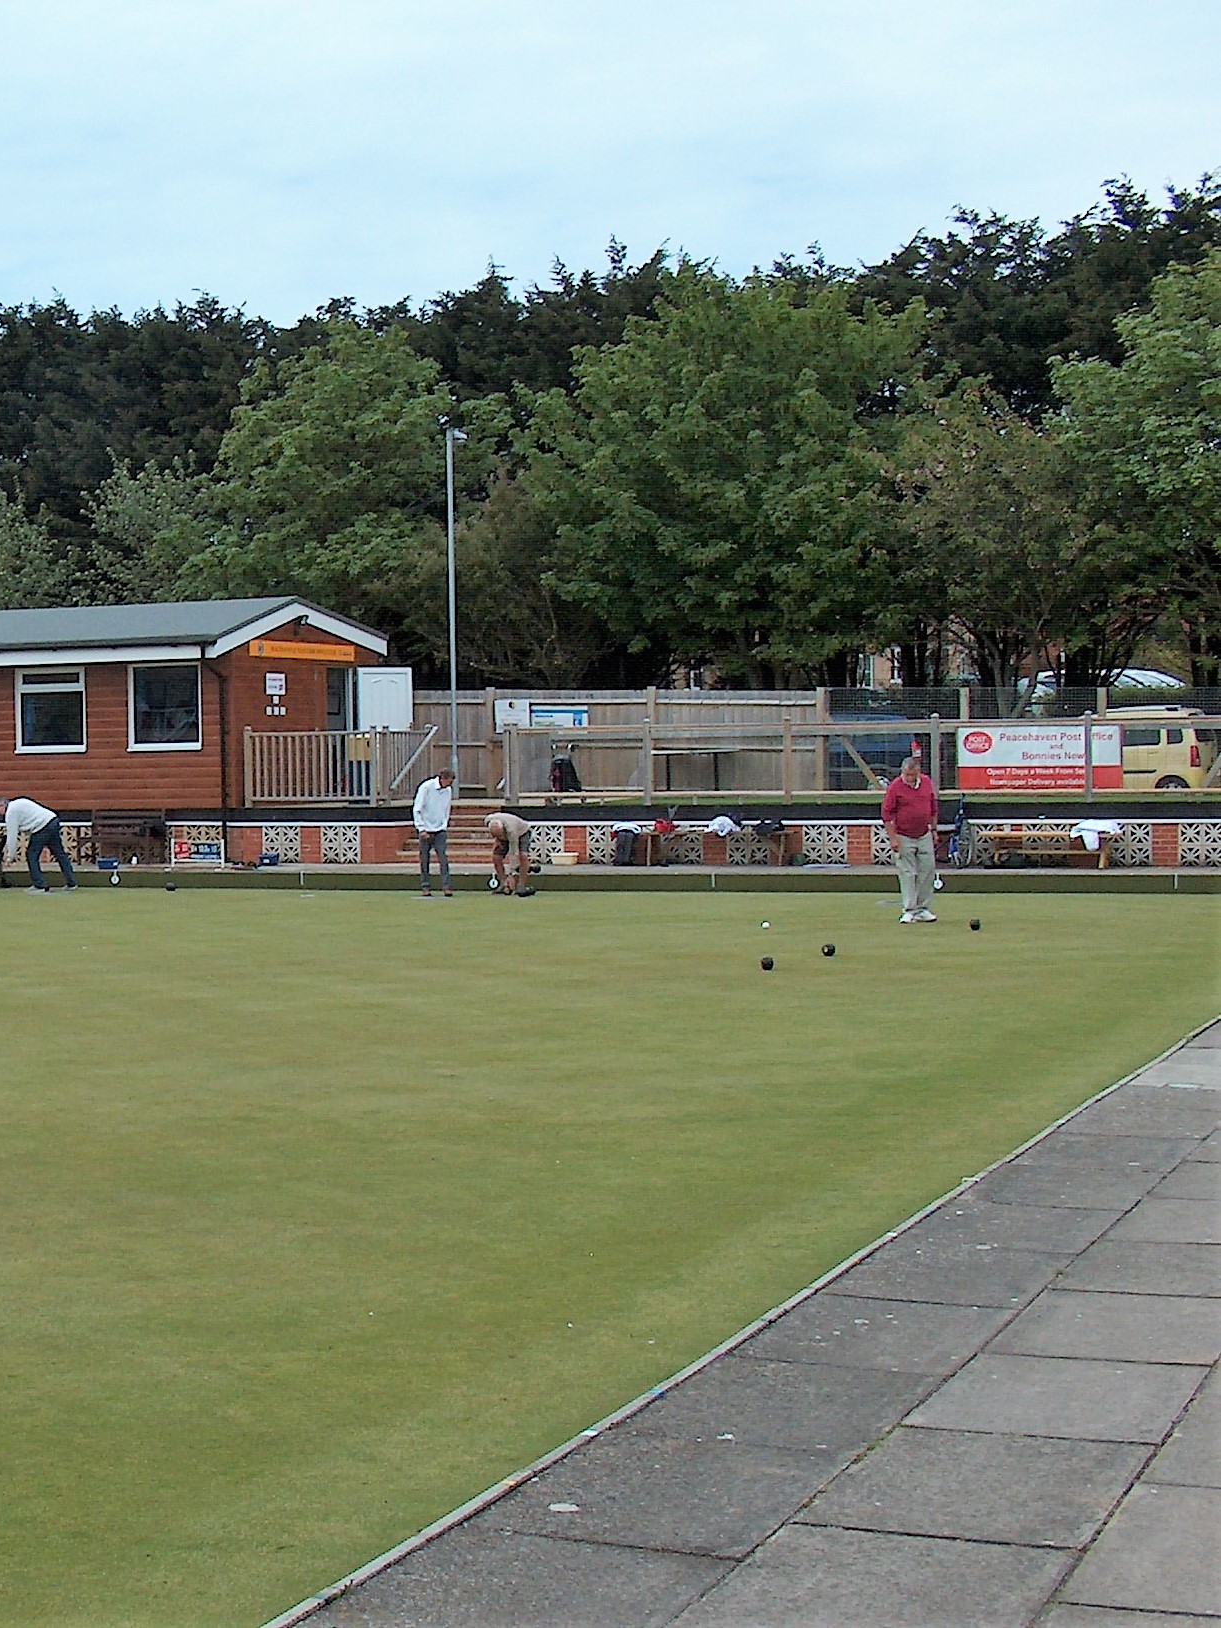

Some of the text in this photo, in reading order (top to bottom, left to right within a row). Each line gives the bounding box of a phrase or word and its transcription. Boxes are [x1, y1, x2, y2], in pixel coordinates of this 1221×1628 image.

[999, 731, 1113, 741] Peacehaven Post ffice
[1021, 751, 1061, 760] Bonnies
[986, 767, 1005, 776] Open
